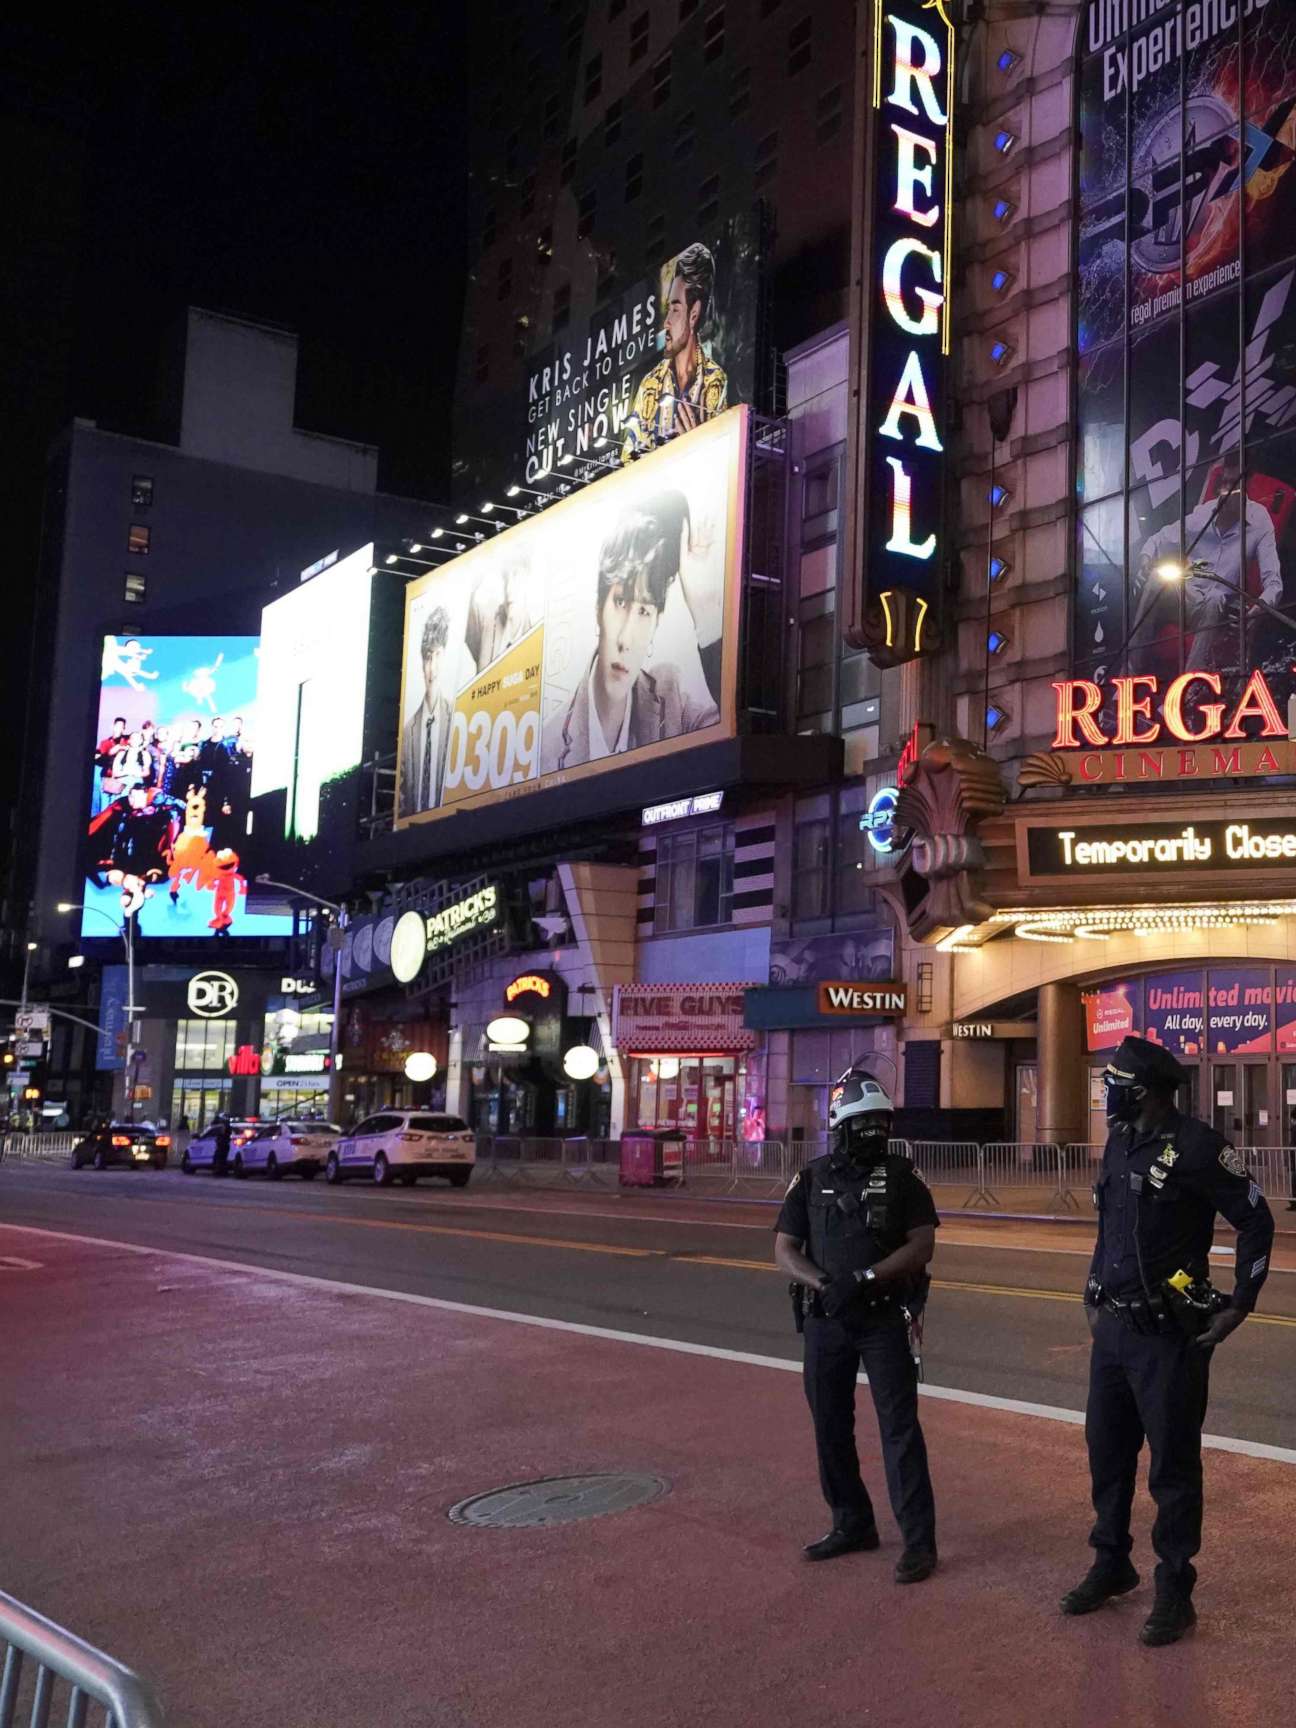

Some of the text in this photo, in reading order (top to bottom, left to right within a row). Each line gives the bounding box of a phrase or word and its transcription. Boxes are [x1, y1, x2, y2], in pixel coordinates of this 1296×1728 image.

[878, 14, 949, 561] REGAL
[1131, 298, 1151, 326] regal
[1193, 259, 1241, 297] experience
[529, 295, 655, 403] KRIS JAMES
[528, 327, 655, 423] GET BACK TO LOVE
[526, 374, 631, 457] NEW SINGLE
[526, 398, 629, 484] OUT NOW
[477, 680, 501, 699] HAPPY
[525, 664, 540, 681] DAY
[445, 710, 540, 791] 0309
[1059, 827, 1212, 866] Temporarily
[620, 995, 744, 1016] FIVE GUYS
[828, 986, 905, 1010] WESTIN
[1149, 981, 1240, 1011] Unlimted
[952, 1023, 993, 1037] WESTIN
[1093, 1017, 1130, 1034] Unlimited
[1164, 1013, 1180, 1030] All
[1210, 1015, 1243, 1032] every
[1244, 1011, 1268, 1031] day.
